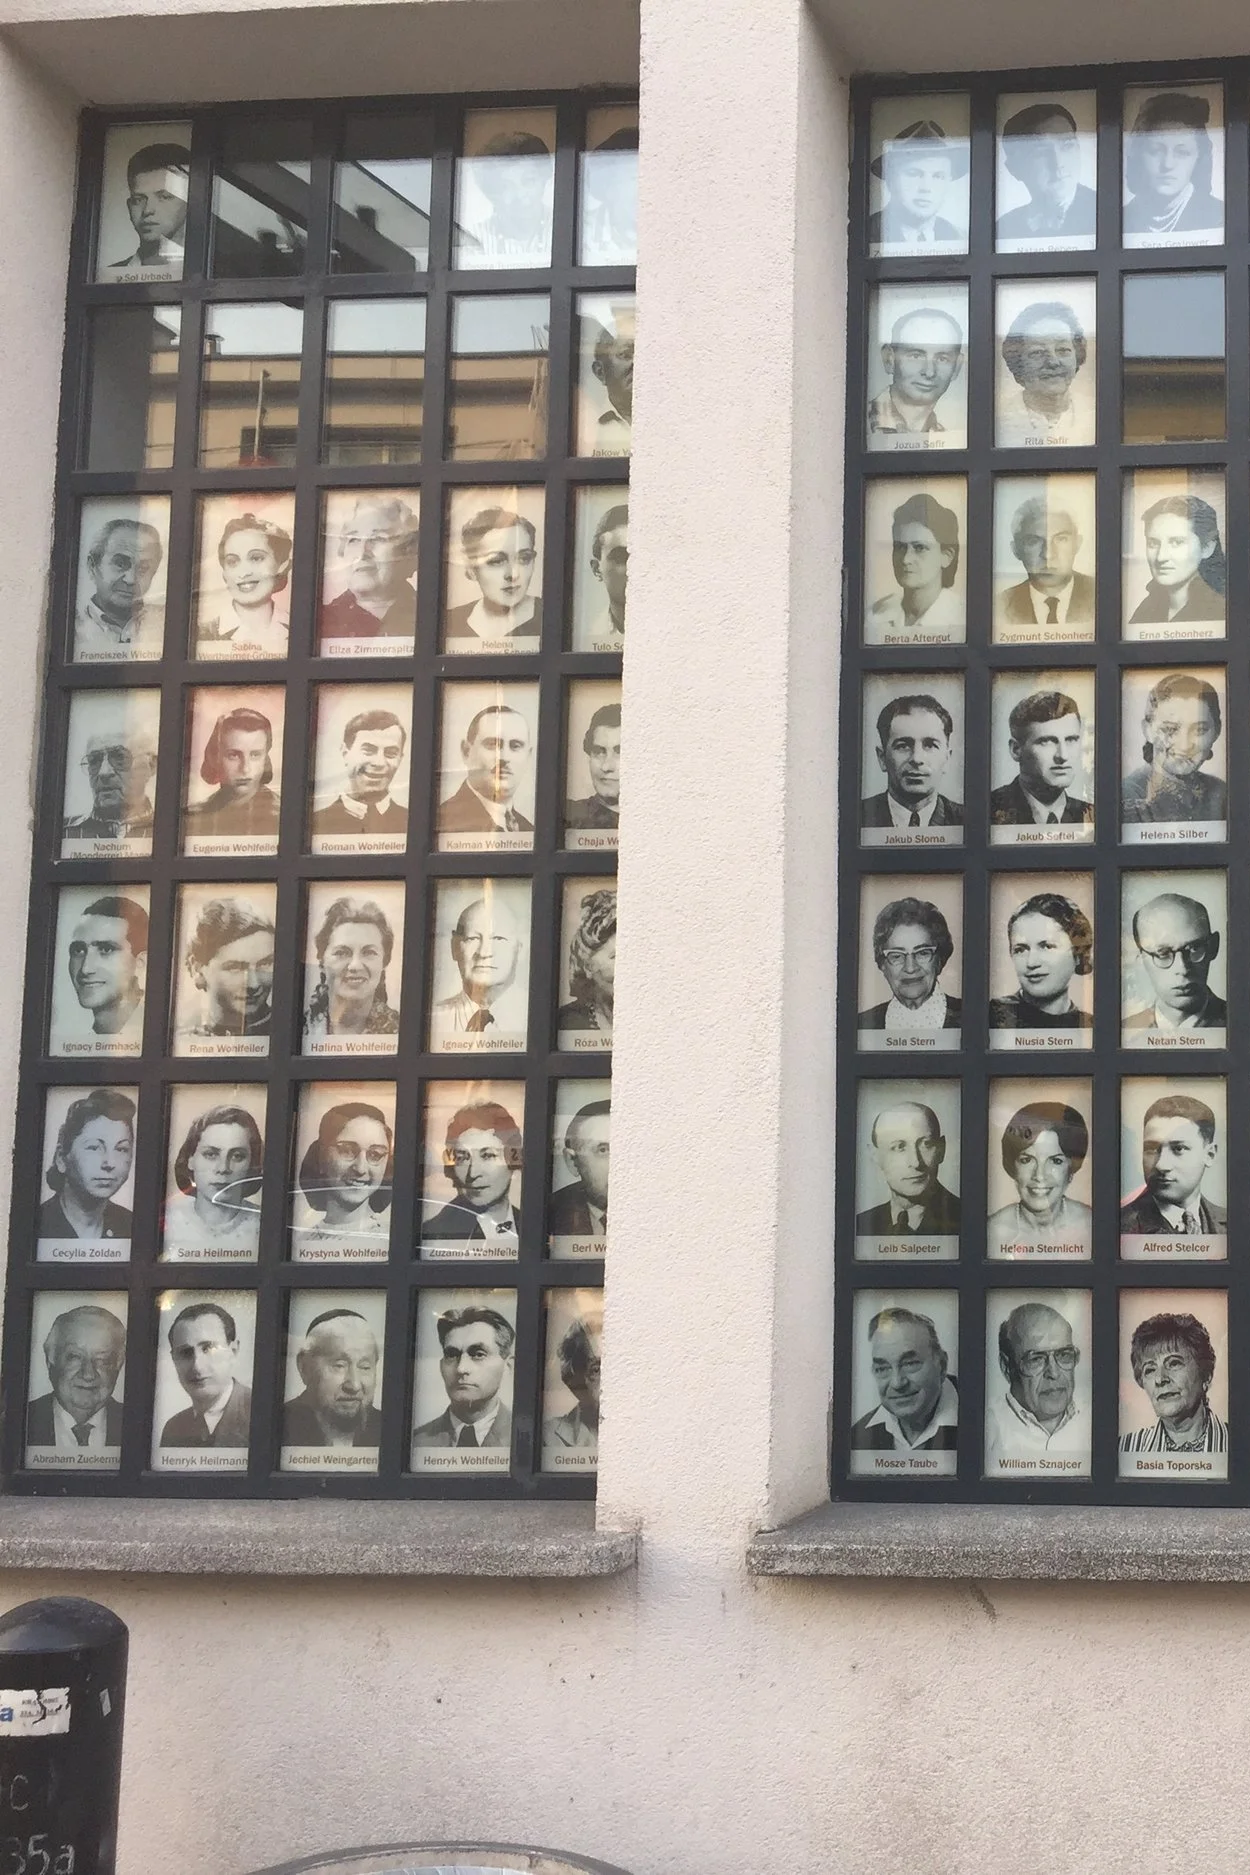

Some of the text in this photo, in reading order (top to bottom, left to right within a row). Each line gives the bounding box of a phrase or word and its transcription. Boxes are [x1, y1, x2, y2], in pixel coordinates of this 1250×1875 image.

[124, 271, 173, 282] Sol Urbach
[893, 440, 921, 451] Jozua
[1024, 436, 1045, 446] Rita
[884, 633, 951, 645] Berta Aftergut
[1000, 632, 1041, 644] Zygmunt
[1139, 630, 1160, 640] Erna
[231, 642, 262, 652] Sabina
[328, 645, 352, 655] Eliza
[592, 642, 610, 651] Tulo
[80, 650, 128, 660] Franciszek
[884, 834, 912, 845] Jakub
[1015, 832, 1044, 842] Jakub
[1140, 829, 1209, 841] Helena Silber
[93, 842, 132, 852] Nachum
[321, 841, 405, 852] Roman Wohlfeiler
[446, 839, 533, 850] Kalman Wohlfeiler
[577, 836, 602, 847] Chaja
[193, 843, 231, 853] Eugenia
[310, 1041, 397, 1052] Halina Wohlfeiler
[442, 1039, 524, 1051] Ignacy Wohlfeiler
[886, 1037, 936, 1047] Sala Stern
[1015, 1036, 1073, 1047] Niusia Stern
[1147, 1036, 1206, 1046] Natan Stern
[62, 1041, 93, 1053] Ignacy
[52, 1247, 122, 1259] Cecylia Zoldan
[177, 1247, 252, 1258] Sara Heilmann
[299, 1248, 341, 1259] Krystyna
[572, 1244, 590, 1253] Berl
[878, 1243, 941, 1256] Leib Salpeter
[1000, 1243, 1084, 1254] Helena Sternlicht
[1143, 1243, 1172, 1253] Alfred
[32, 1454, 74, 1464] Abraham
[161, 1455, 249, 1467] Henryk Heilmann
[288, 1455, 378, 1467] Jechiel Weingarten
[423, 1455, 509, 1467] Henryk Wohlfeiler
[554, 1455, 587, 1465] Gienia
[874, 1458, 938, 1469] Mosze Taube
[998, 1459, 1082, 1472] William Sznajcer
[1136, 1460, 1212, 1472] Basia Toporska
